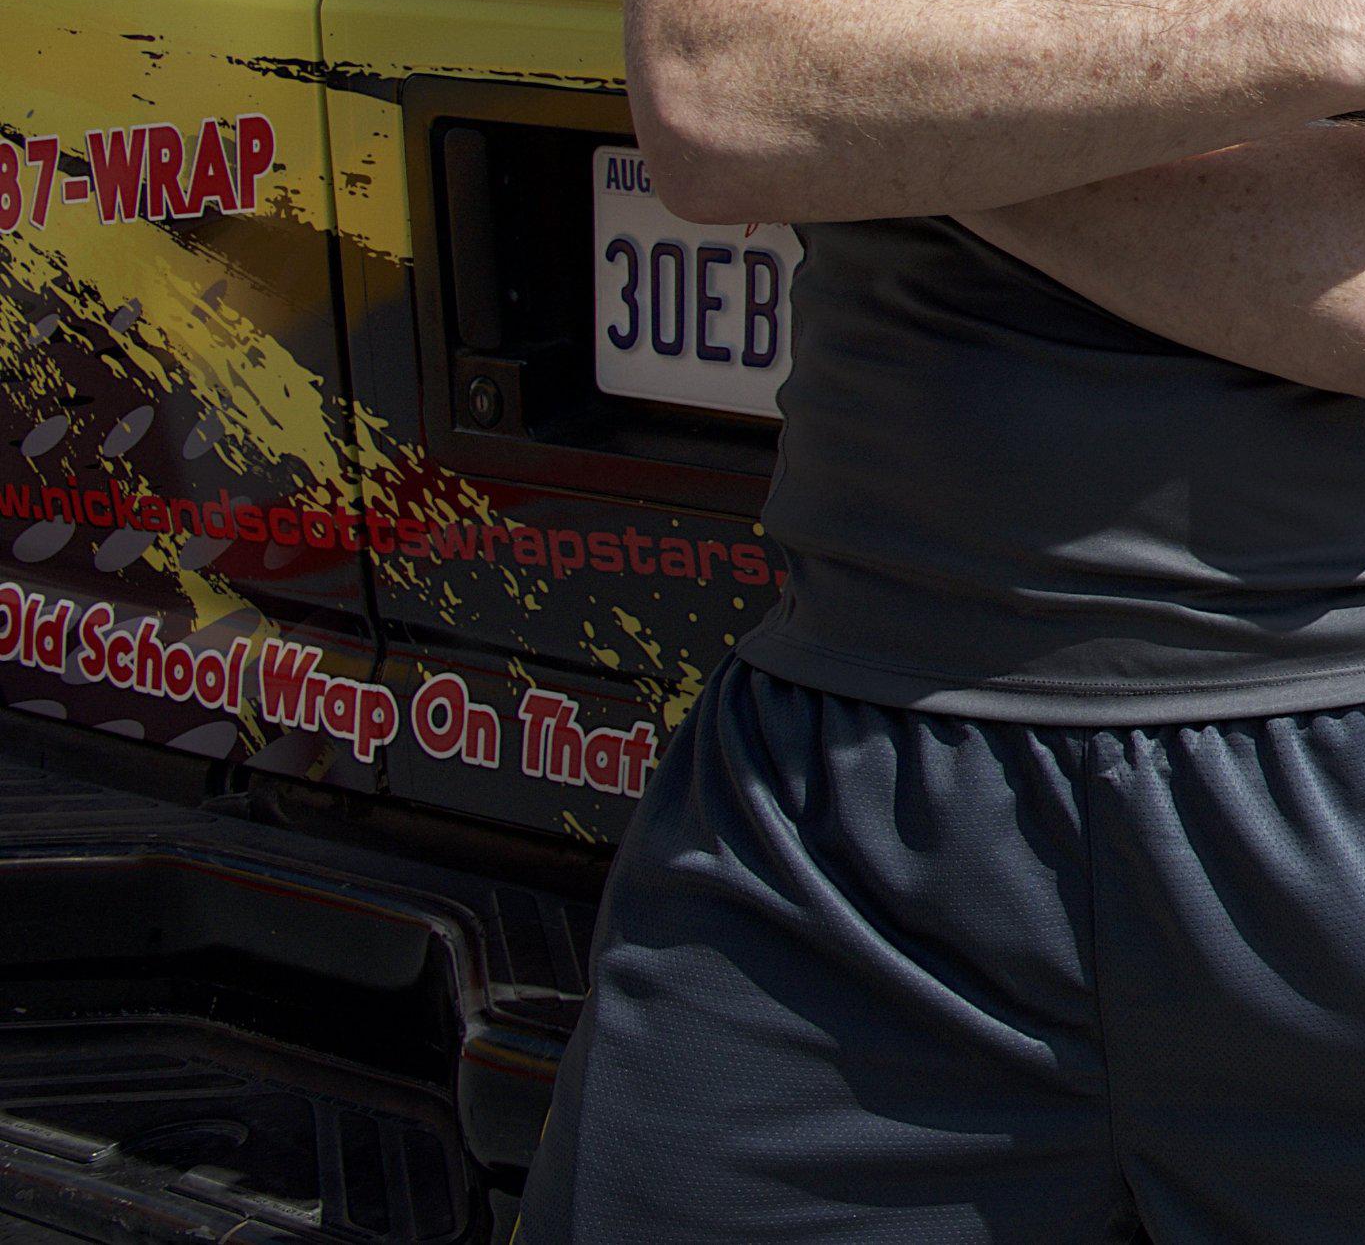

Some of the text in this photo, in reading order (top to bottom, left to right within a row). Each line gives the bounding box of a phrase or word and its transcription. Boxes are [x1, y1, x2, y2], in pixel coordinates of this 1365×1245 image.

[606, 157, 650, 193] AUG
[606, 239, 779, 368] 30EB
[0, 581, 656, 799] Old School Wrap On That
